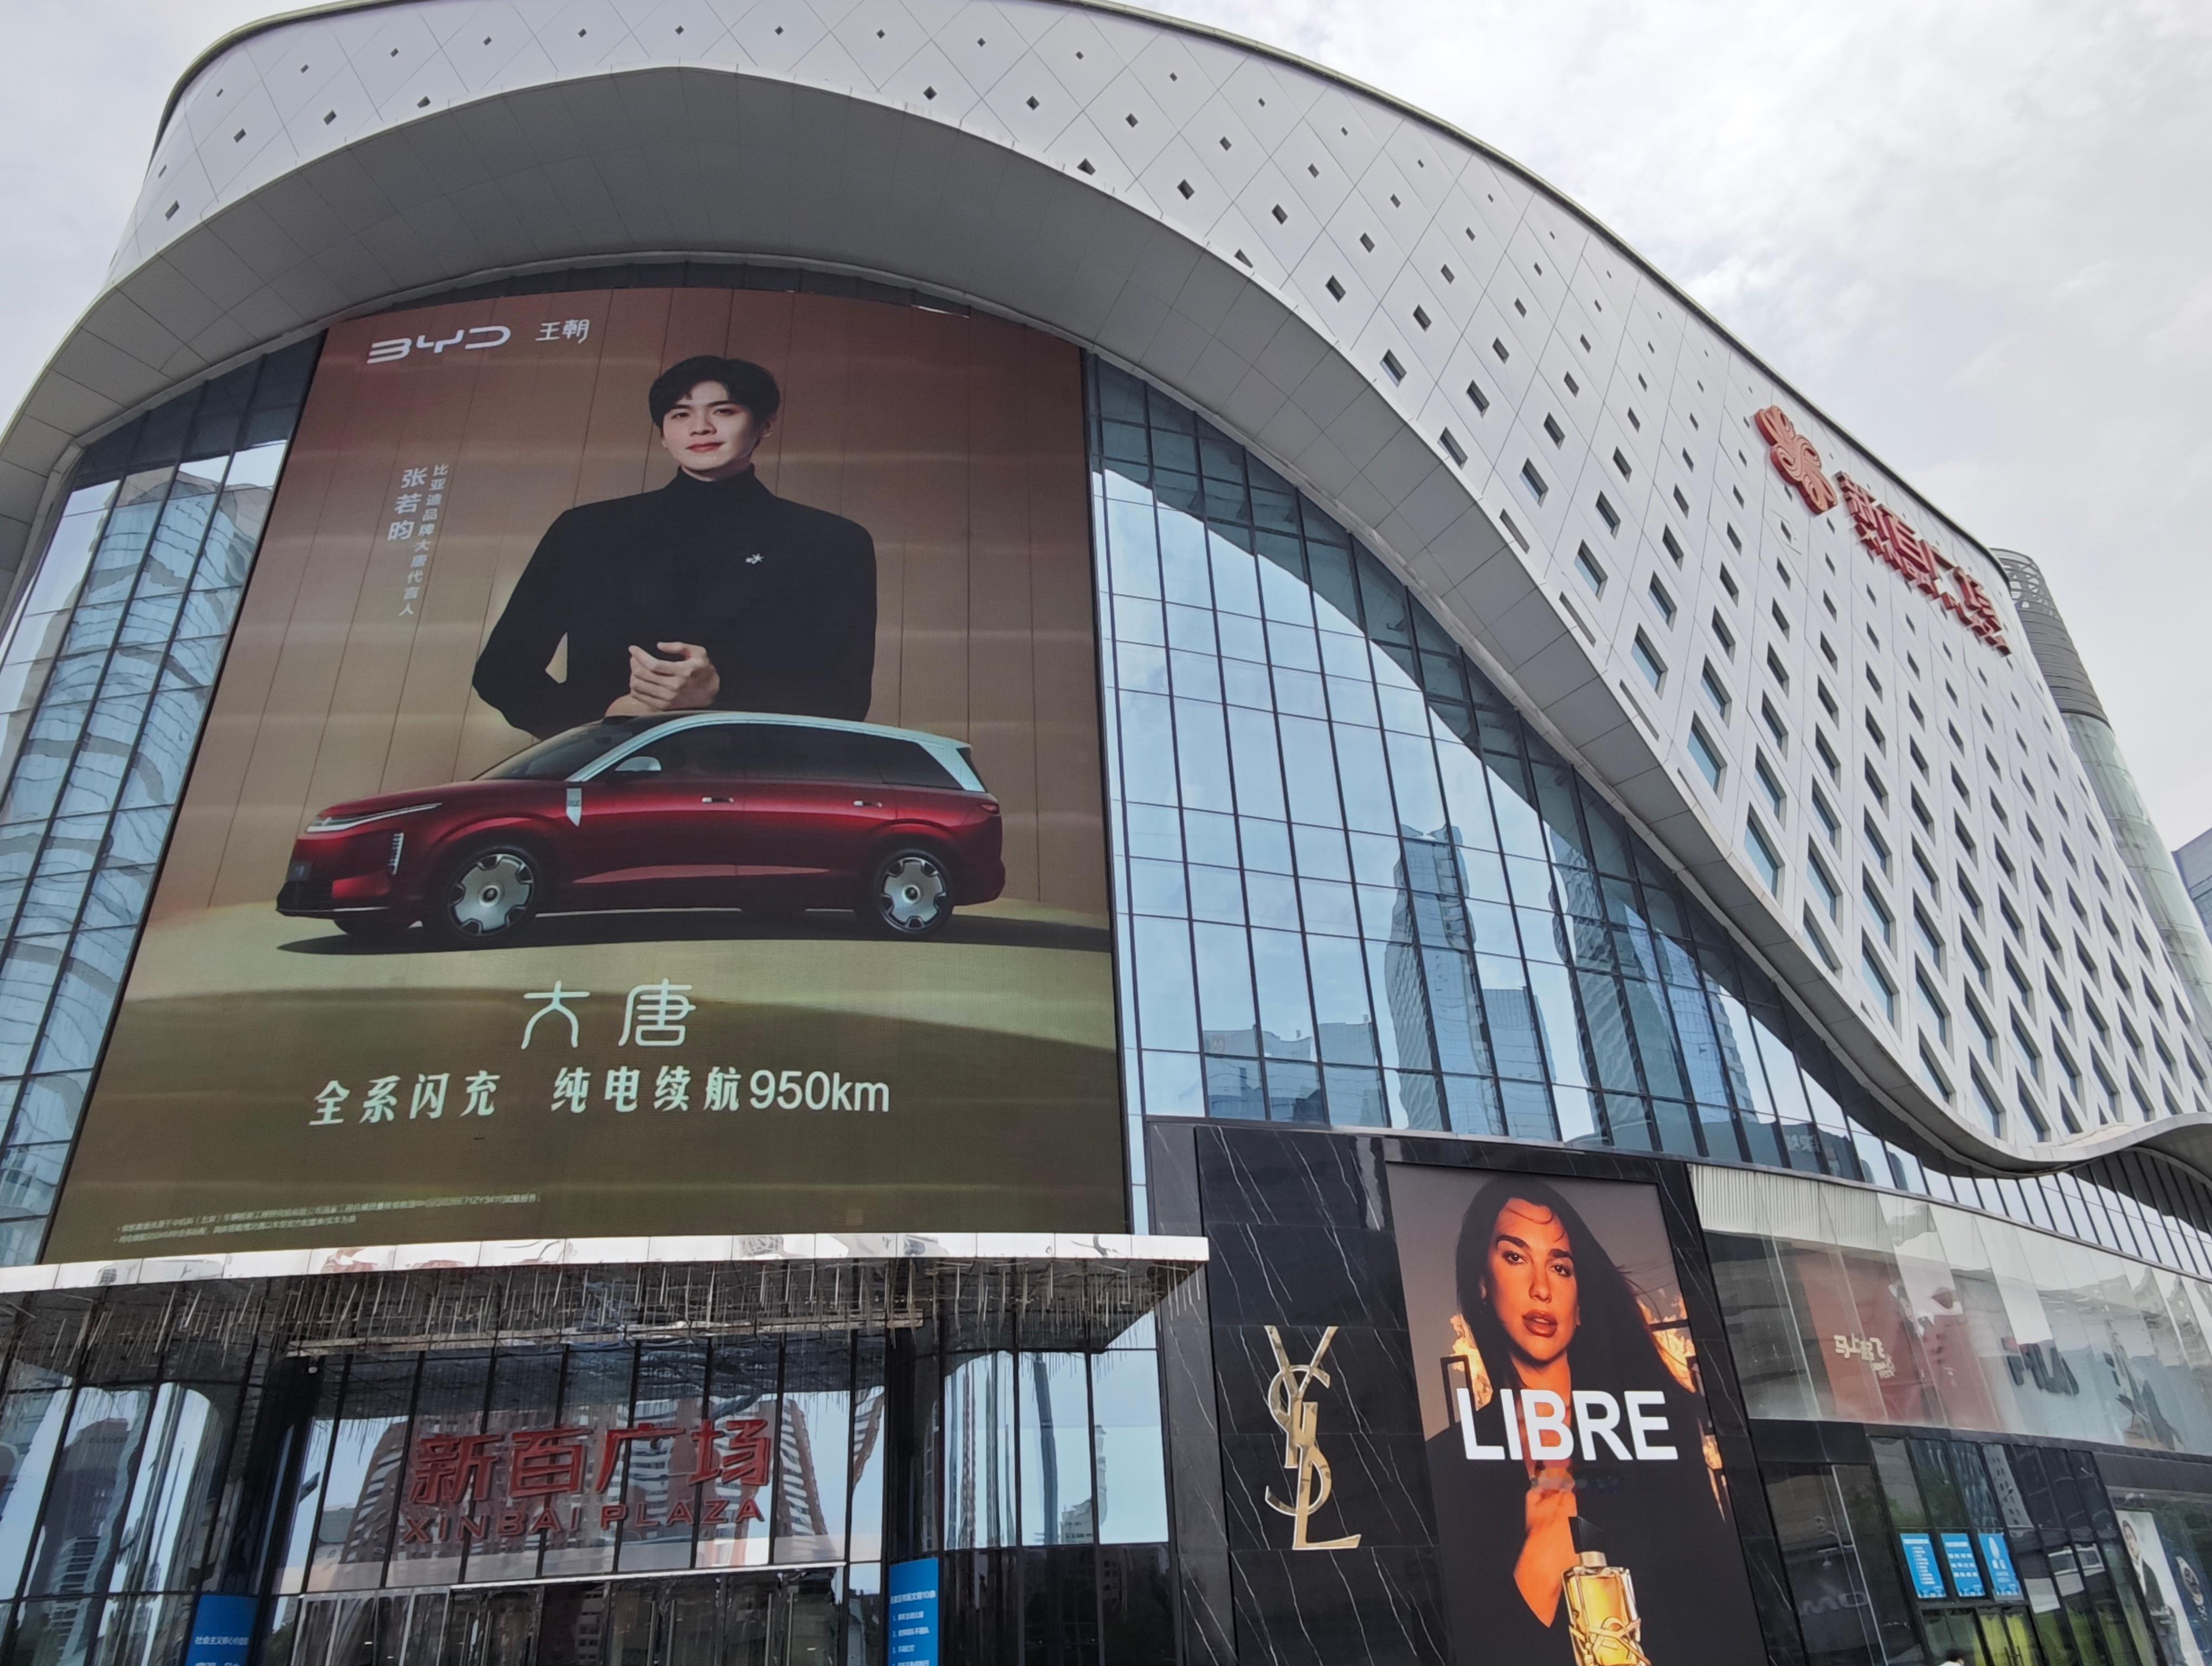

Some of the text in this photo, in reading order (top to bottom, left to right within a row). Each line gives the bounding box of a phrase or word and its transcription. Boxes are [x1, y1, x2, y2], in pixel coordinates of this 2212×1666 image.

[366, 325, 511, 364] BYD
[535, 318, 590, 344] 王朝
[387, 466, 427, 541] 张若昀
[398, 464, 448, 616] 比亚迪品牌大唐代言人
[520, 978, 696, 1049] 大唐
[308, 1066, 890, 1126] 全系闪充 纯电续航950km
[1456, 1387, 1679, 1461] LIBRE
[409, 1418, 771, 1505] 新百广场
[401, 1497, 765, 1543] XINBAI PLAZA
